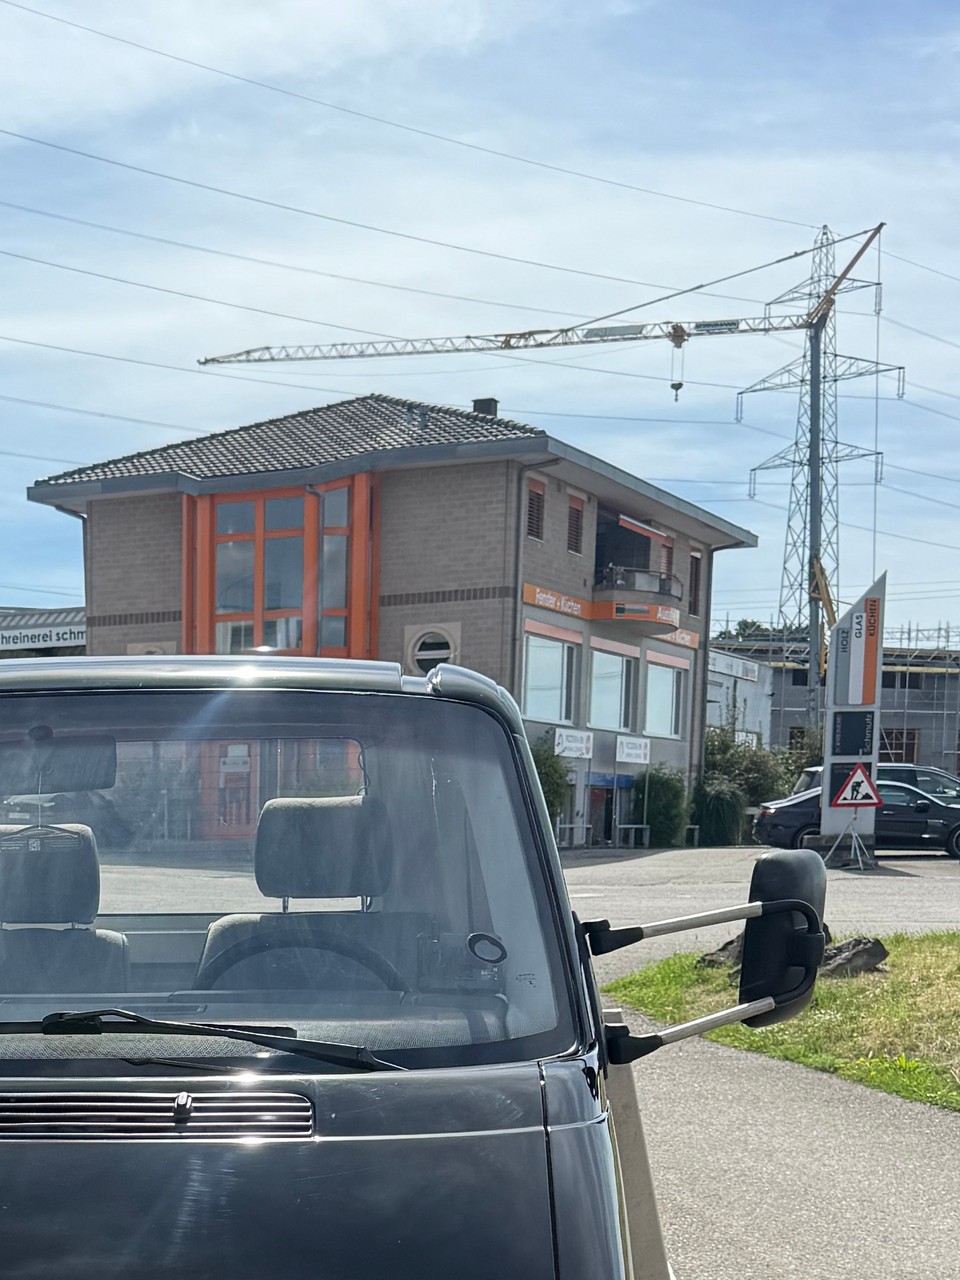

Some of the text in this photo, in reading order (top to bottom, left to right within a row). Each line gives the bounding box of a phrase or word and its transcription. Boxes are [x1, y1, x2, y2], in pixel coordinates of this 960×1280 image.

[855, 614, 863, 638] GLAS
[868, 600, 877, 637] KÜCHEN
[841, 630, 849, 653] HOLZ
[864, 713, 873, 753] Schmutz
